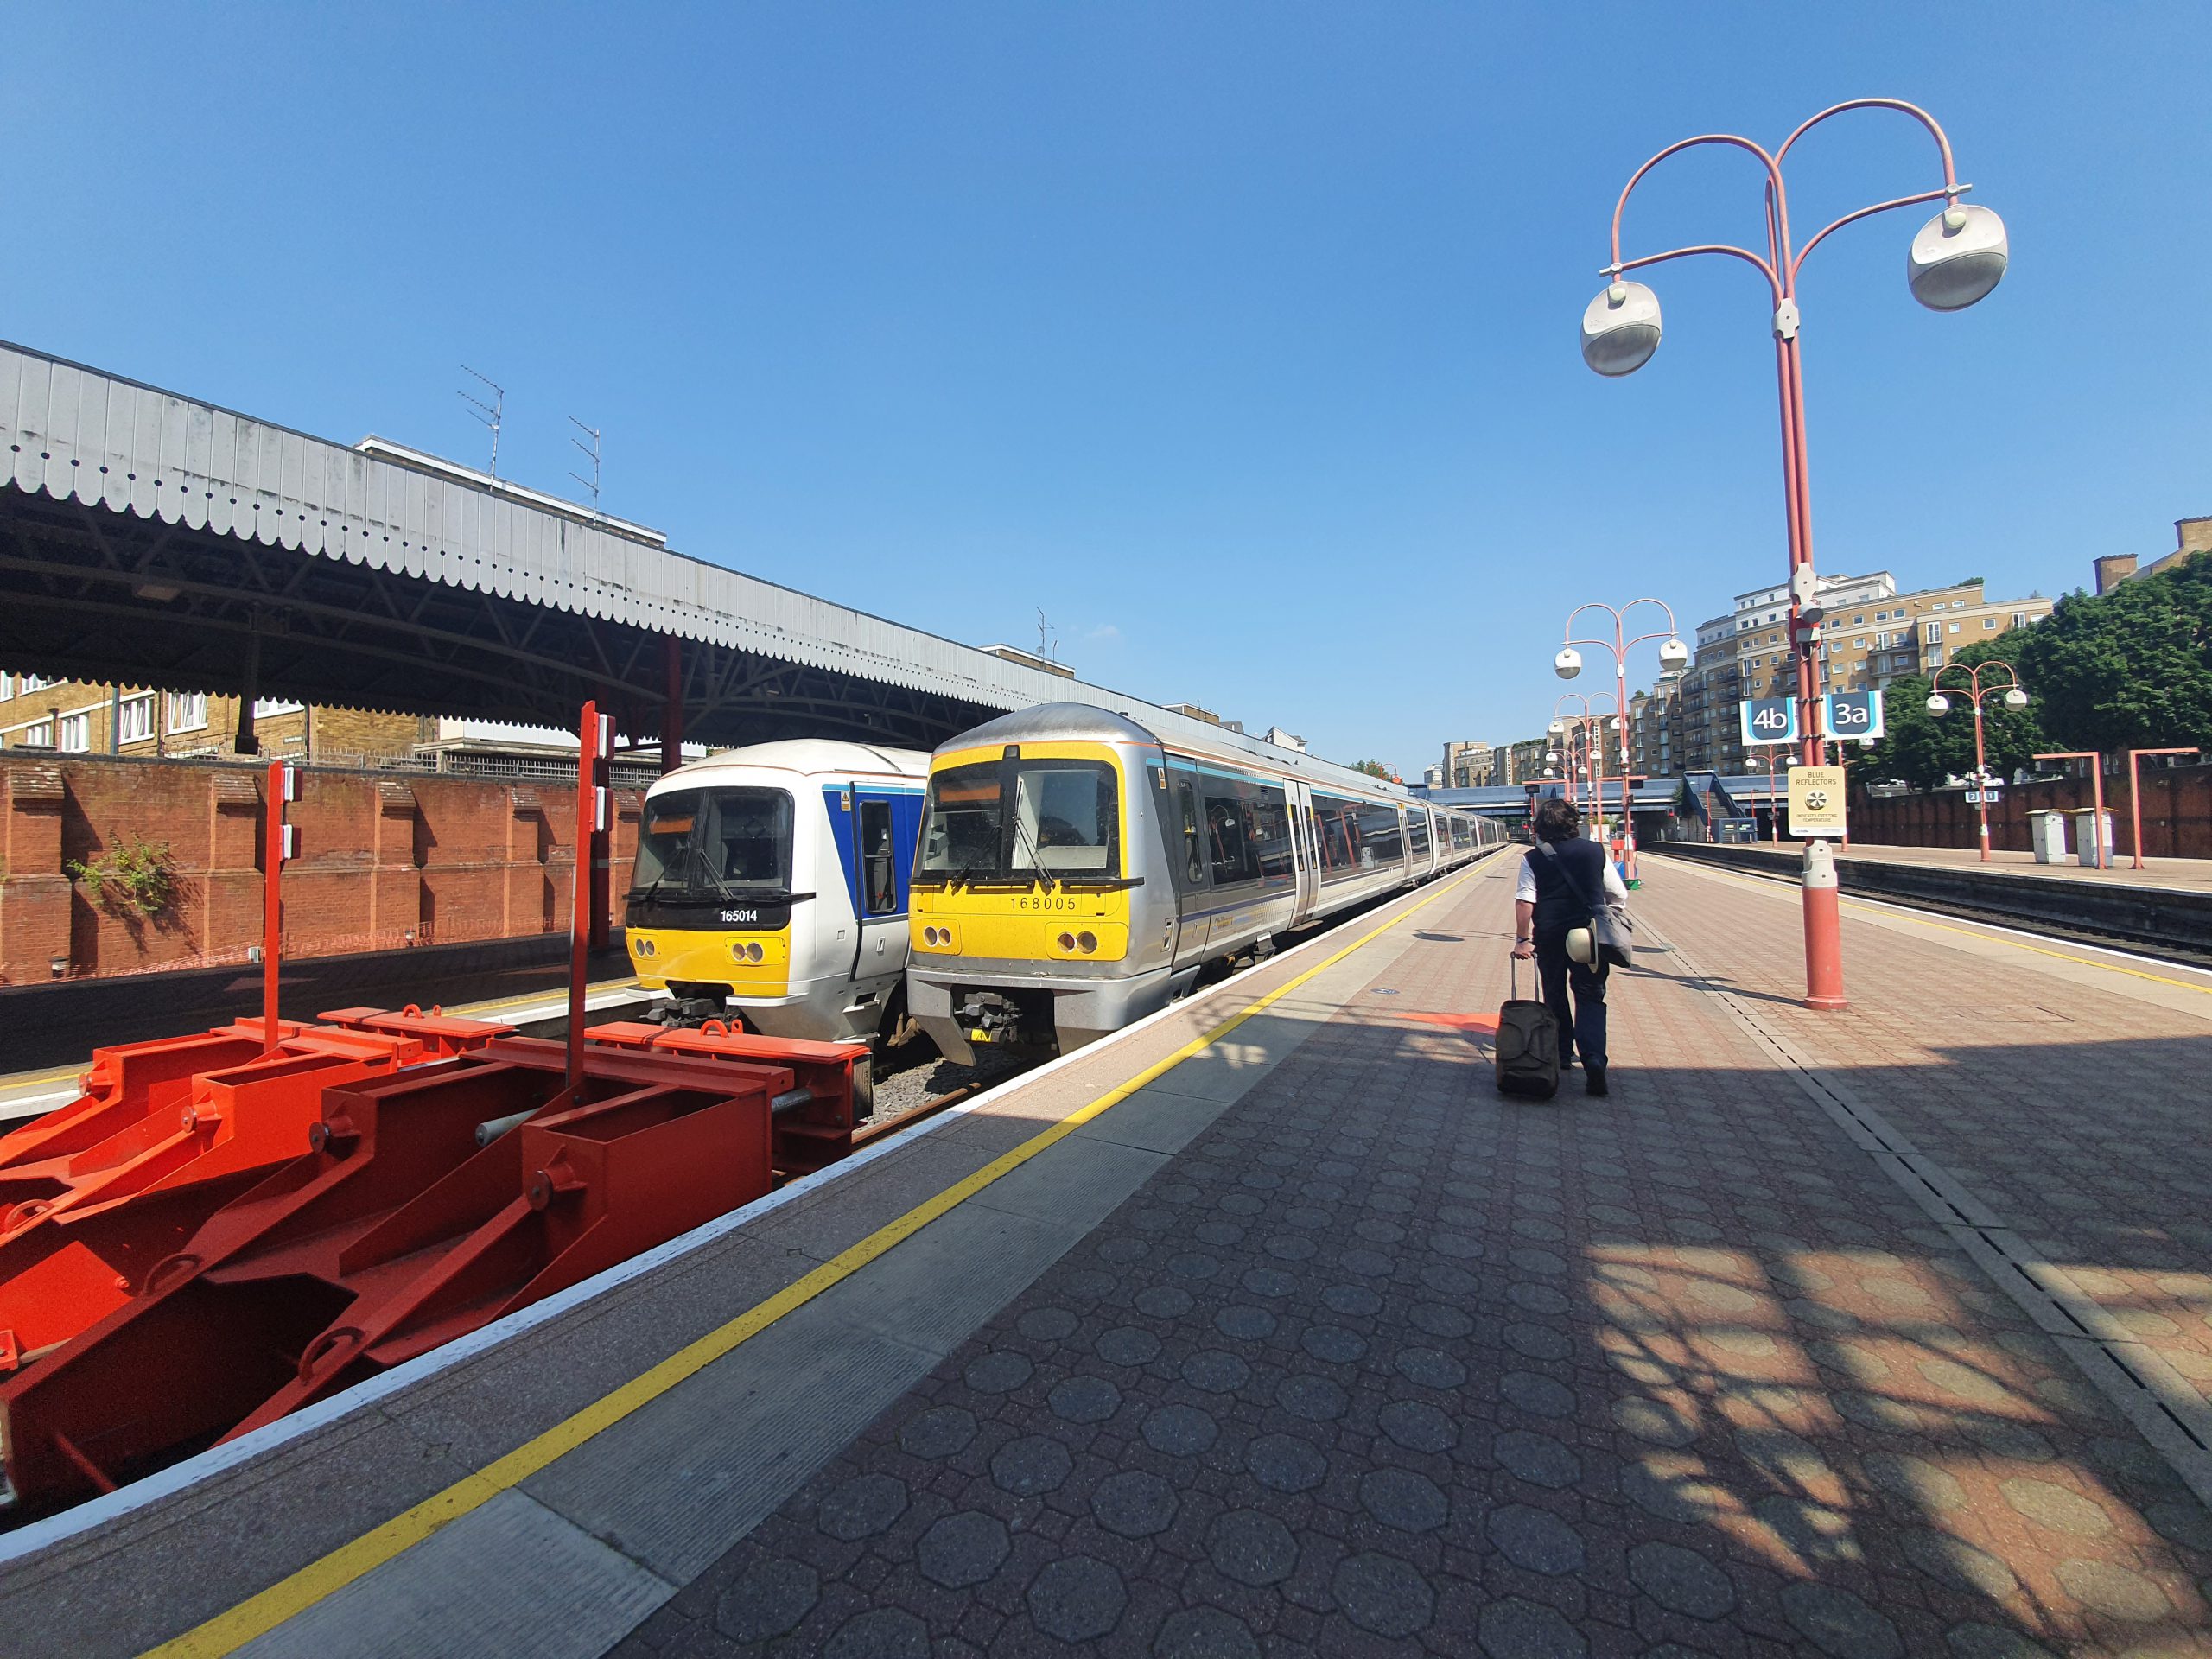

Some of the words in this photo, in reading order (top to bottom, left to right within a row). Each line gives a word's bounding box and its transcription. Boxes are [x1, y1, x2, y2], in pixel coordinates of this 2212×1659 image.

[1752, 707, 1788, 729] 4b
[1835, 703, 1868, 725] 3a
[1011, 897, 1076, 910] 168005
[721, 910, 757, 922] 165014
